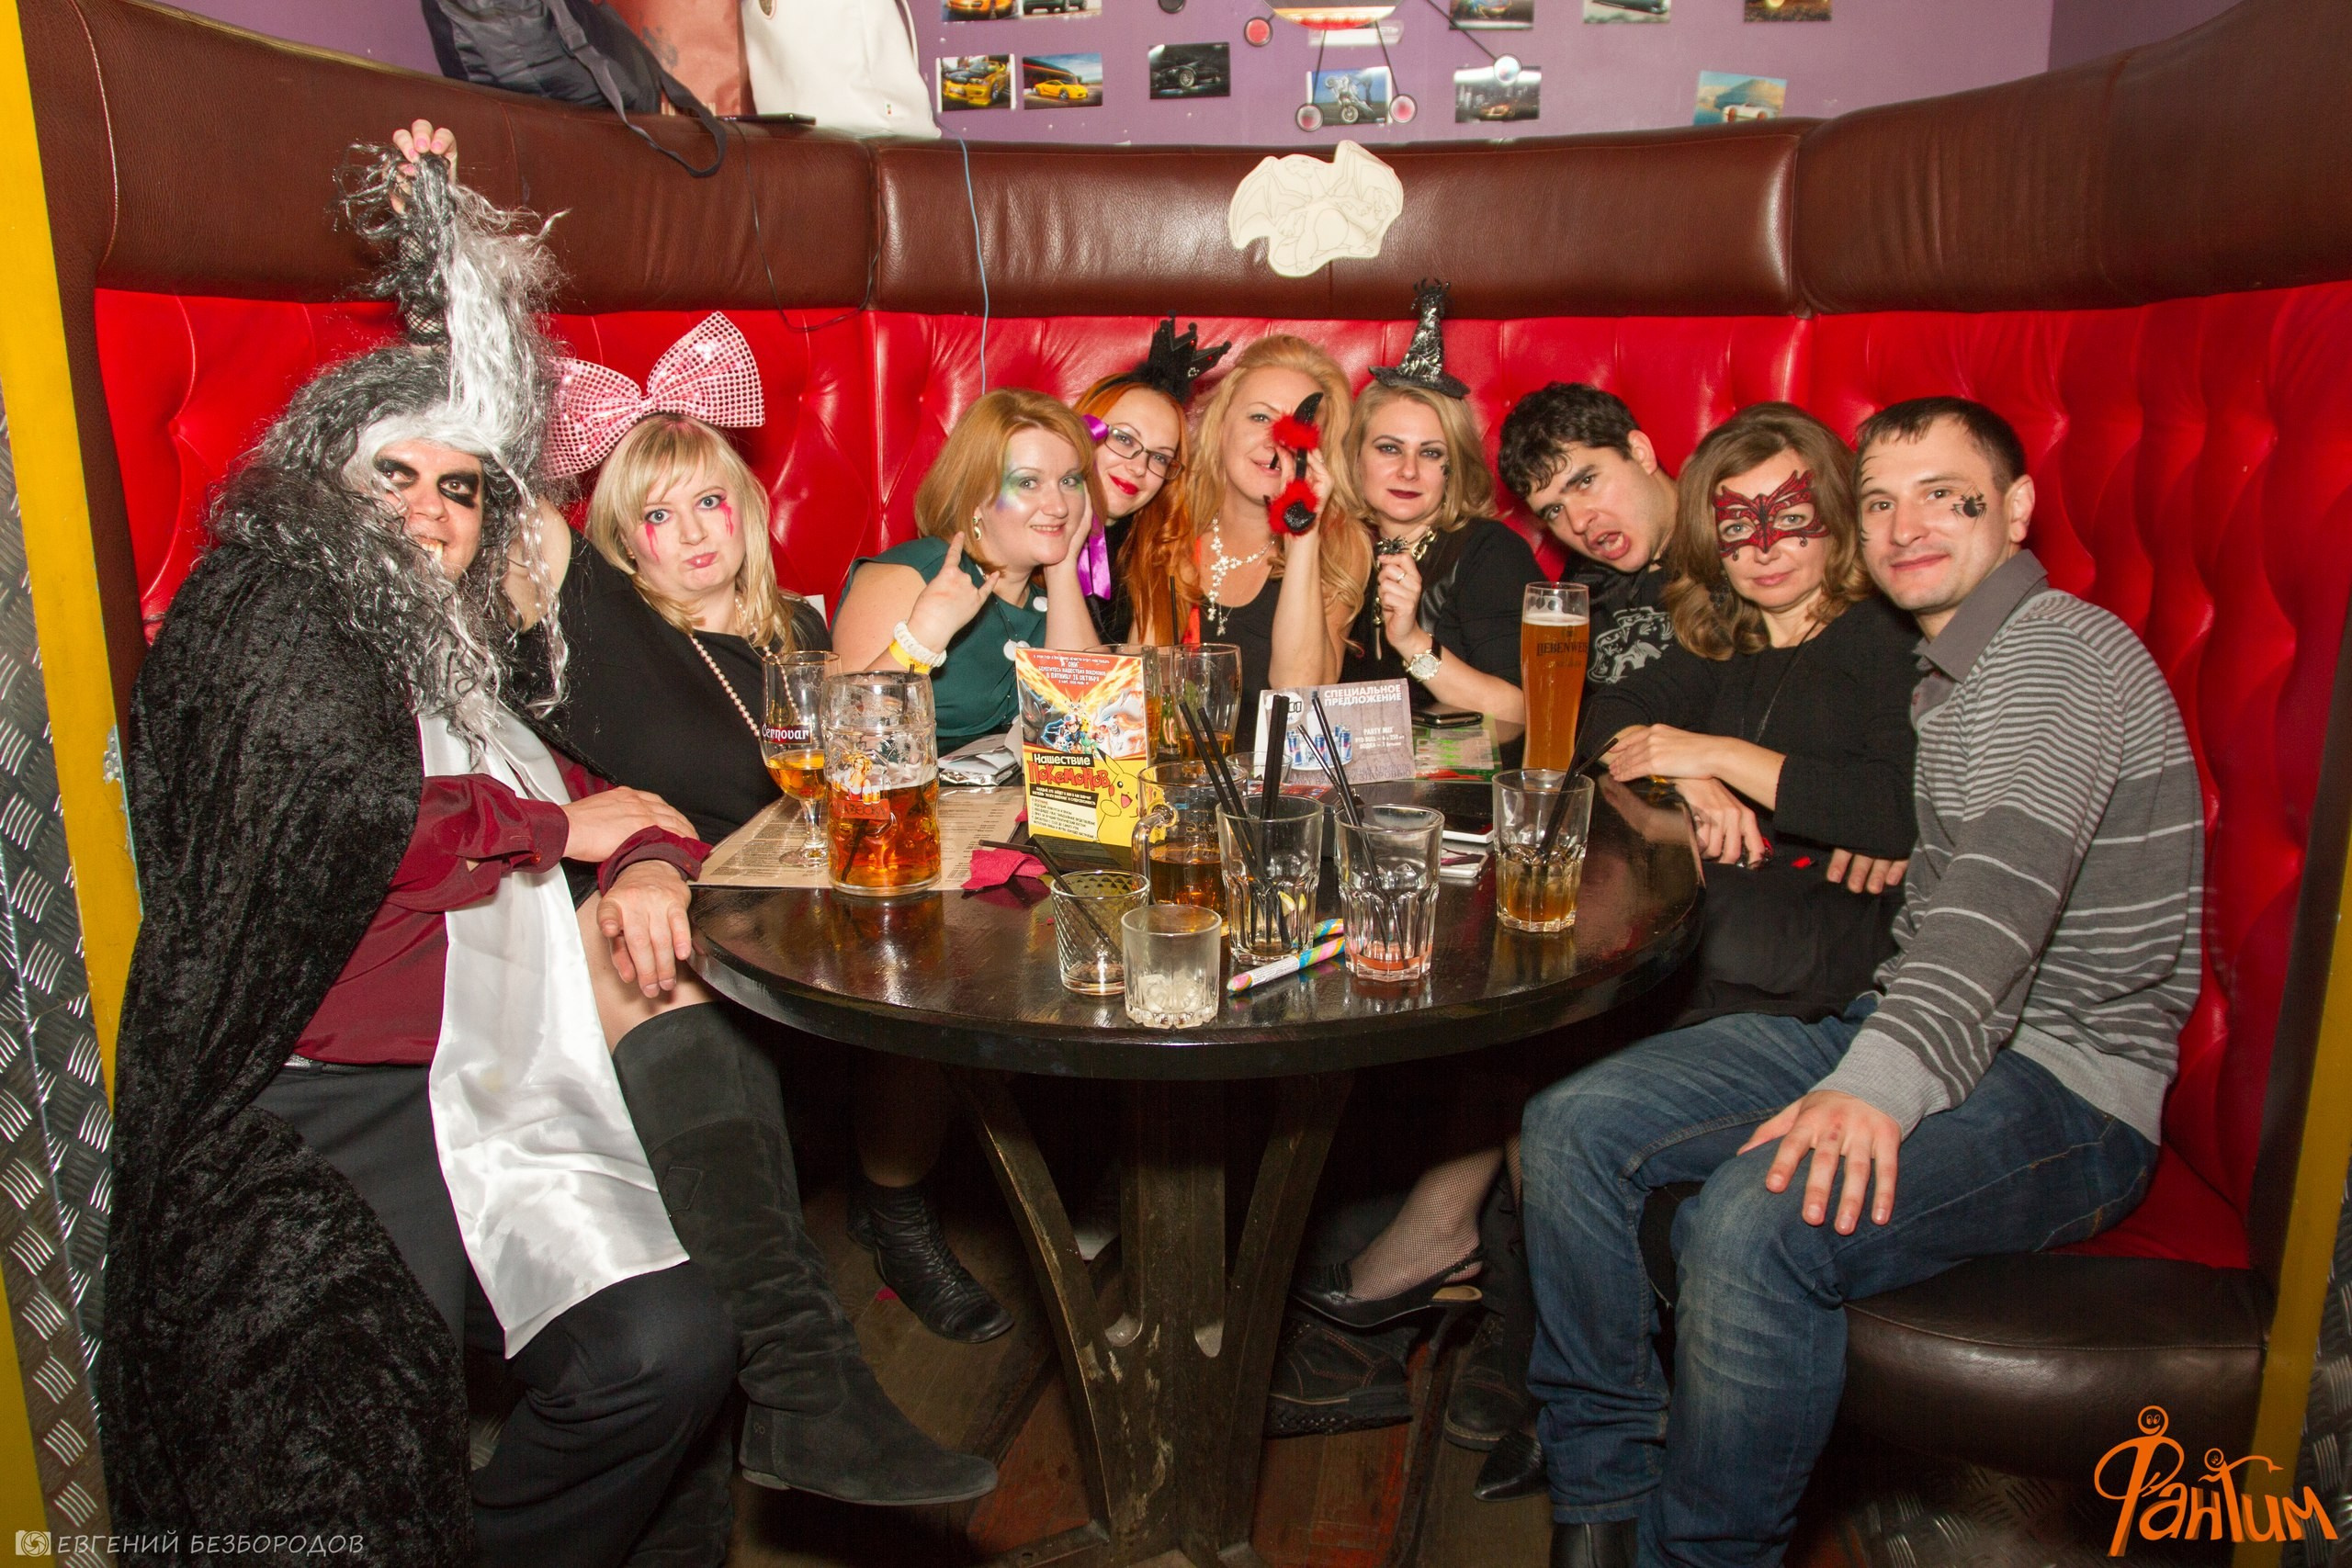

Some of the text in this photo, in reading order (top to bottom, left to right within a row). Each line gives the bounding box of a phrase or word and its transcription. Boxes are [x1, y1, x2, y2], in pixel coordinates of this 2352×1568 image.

[1324, 684, 1401, 698] СПЕЦИАЛЬНОЕ
[1324, 693, 1402, 706] ПРЕДЛОЖЕНИЕ
[762, 723, 809, 741] Cernovar
[1363, 726, 1395, 736] PARTY MIX
[1034, 753, 1091, 766] Нашествие
